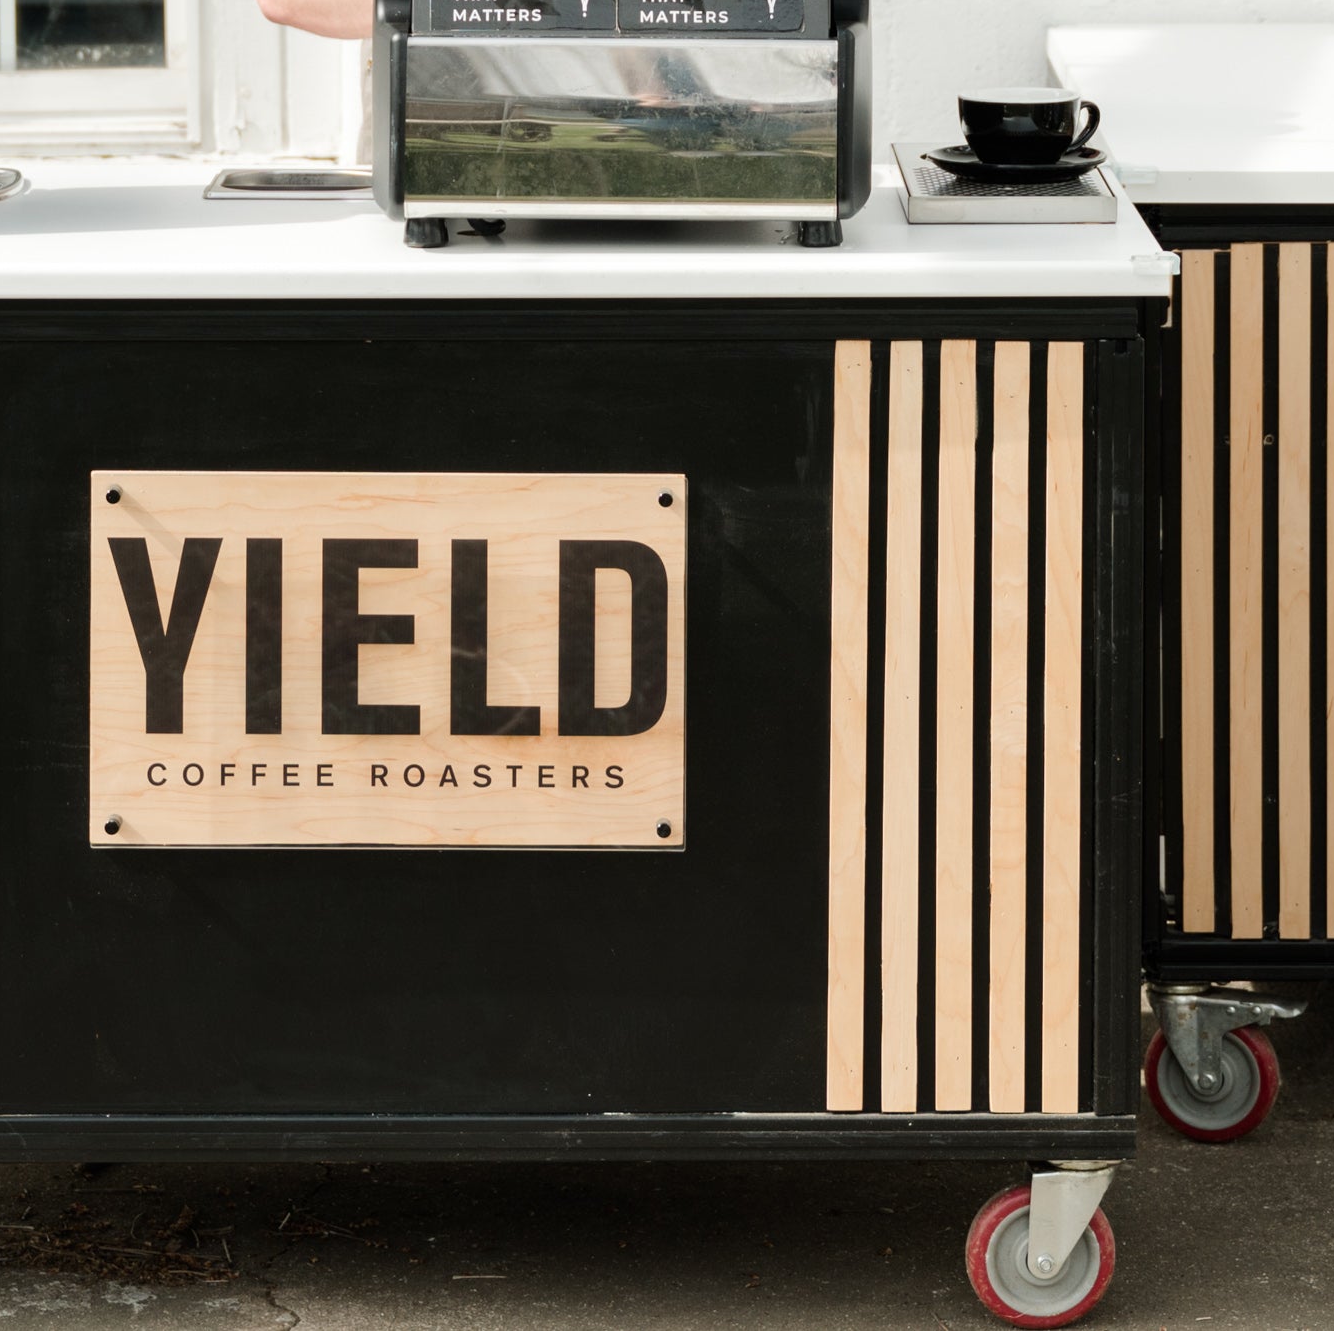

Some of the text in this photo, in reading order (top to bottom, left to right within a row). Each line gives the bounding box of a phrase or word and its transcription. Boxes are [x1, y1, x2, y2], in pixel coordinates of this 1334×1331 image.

[452, 8, 542, 22] MATTERS
[639, 9, 729, 24] MATTERS
[107, 537, 669, 737] YIELD
[146, 762, 626, 789] COFFEE ROASTERS
